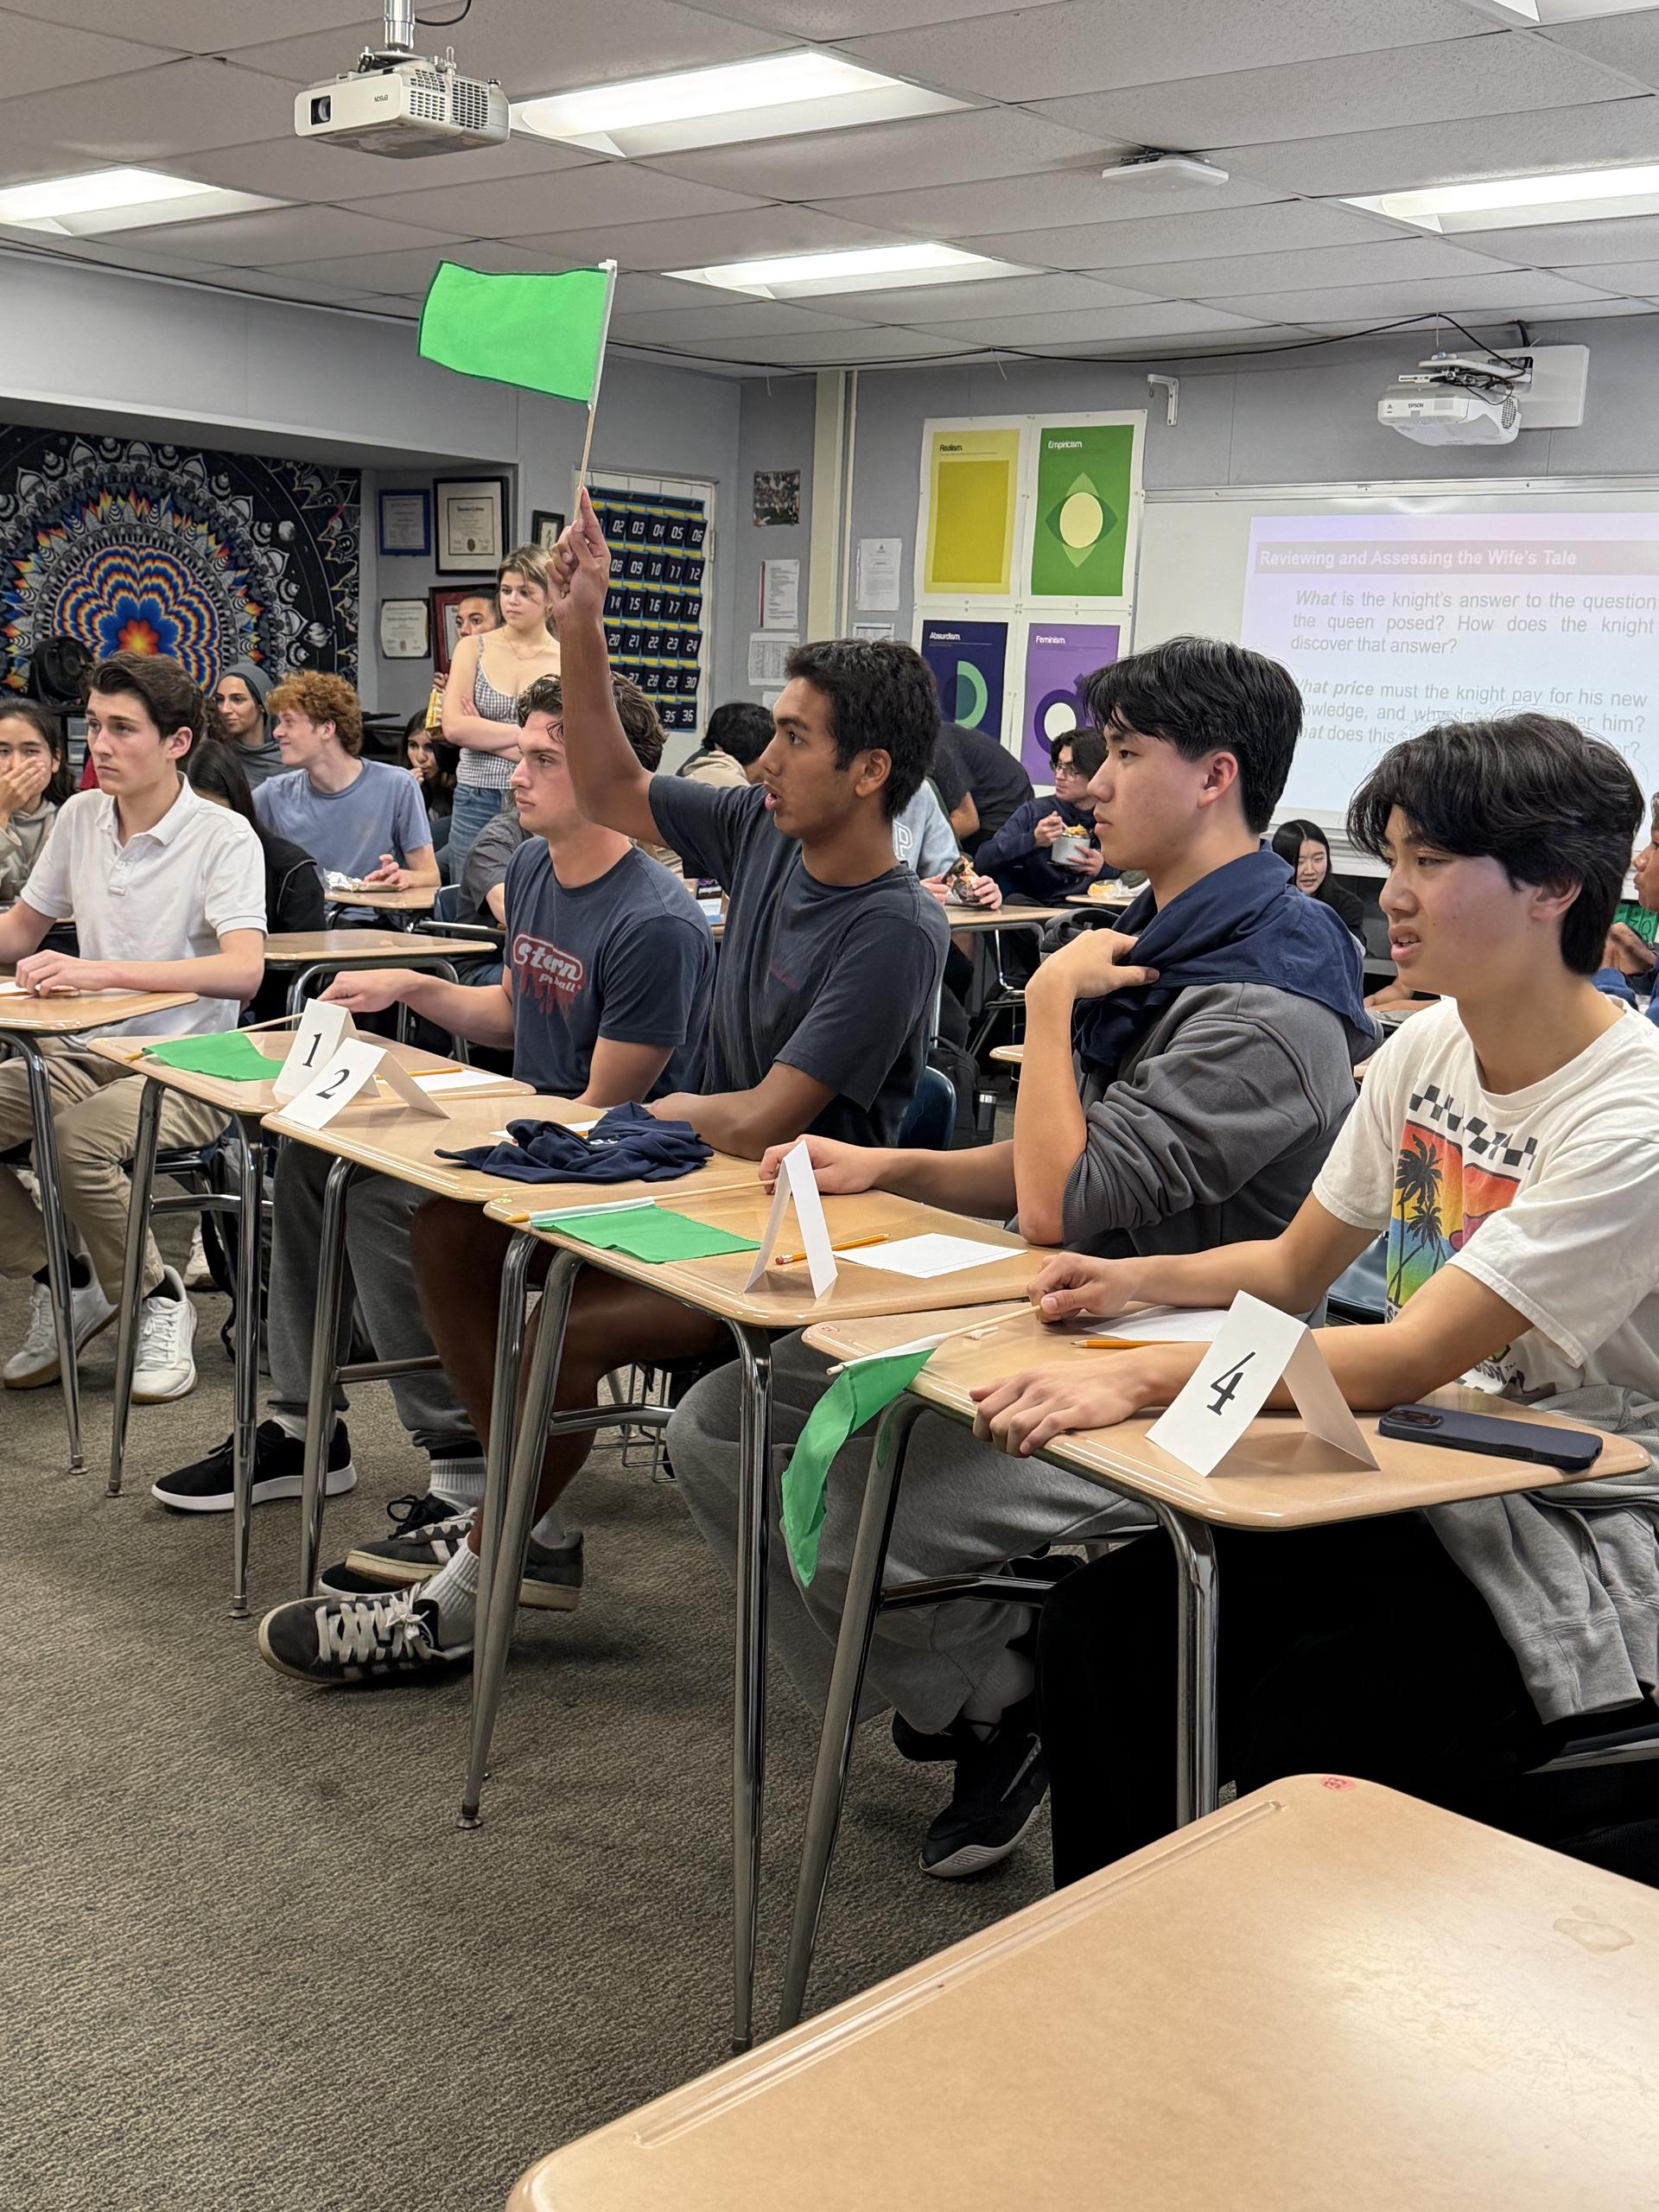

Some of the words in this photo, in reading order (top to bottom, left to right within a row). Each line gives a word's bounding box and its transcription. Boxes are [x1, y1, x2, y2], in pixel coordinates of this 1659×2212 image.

[612, 520, 625, 532] 02
[632, 521, 645, 534] 03
[671, 525, 683, 539] 05
[691, 529, 703, 543] 06
[1260, 550, 1335, 568] Reviewing
[1339, 551, 1367, 565] and
[1371, 550, 1452, 568] Assessing
[1458, 550, 1483, 565] the
[1543, 550, 1577, 565] Tale
[630, 561, 643, 575] 09
[651, 563, 662, 575] 10
[670, 565, 681, 579] 11
[690, 568, 701, 581] 12
[610, 595, 621, 609] 14
[629, 597, 640, 610] 15
[649, 598, 661, 613] 16
[668, 601, 680, 614] 17
[687, 601, 699, 615] 18
[1296, 590, 1337, 606] What
[1343, 591, 1354, 606] is
[1362, 592, 1385, 606] the
[1459, 594, 1521, 607] answer
[1526, 594, 1541, 607] to
[1549, 593, 1575, 607] the
[1583, 594, 1657, 612] question
[1293, 613, 1315, 627] the
[1327, 616, 1374, 631] queen
[1387, 614, 1445, 632] posed?
[1458, 616, 1494, 632] How
[1507, 616, 1547, 632] does
[1561, 617, 1587, 632] the
[1602, 617, 1655, 637] knight
[608, 633, 620, 646] 20
[628, 634, 639, 648] 21
[648, 636, 659, 648] 22
[666, 637, 678, 650] 23
[686, 639, 698, 652] 24
[1291, 636, 1352, 651] discover
[1357, 637, 1385, 651] that
[1390, 639, 1458, 654] answer?
[647, 675, 659, 687] 28
[666, 676, 678, 688] 29
[684, 677, 696, 689] 30
[1333, 680, 1374, 698] price
[1381, 684, 1417, 698] must
[1426, 685, 1449, 699] the
[1457, 685, 1505, 704] knight
[1512, 690, 1542, 704] pay
[1550, 688, 1573, 702] for
[1579, 689, 1603, 705] his
[1611, 693, 1648, 707] new
[664, 710, 676, 722] 35
[682, 709, 694, 722] 36
[1376, 705, 1405, 720] and
[1602, 714, 1645, 733] him?
[1327, 725, 1363, 741] does
[1369, 726, 1395, 744] this
[302, 1033, 322, 1067] 1
[315, 1069, 350, 1099] 2
[1206, 1351, 1255, 1416] 4
